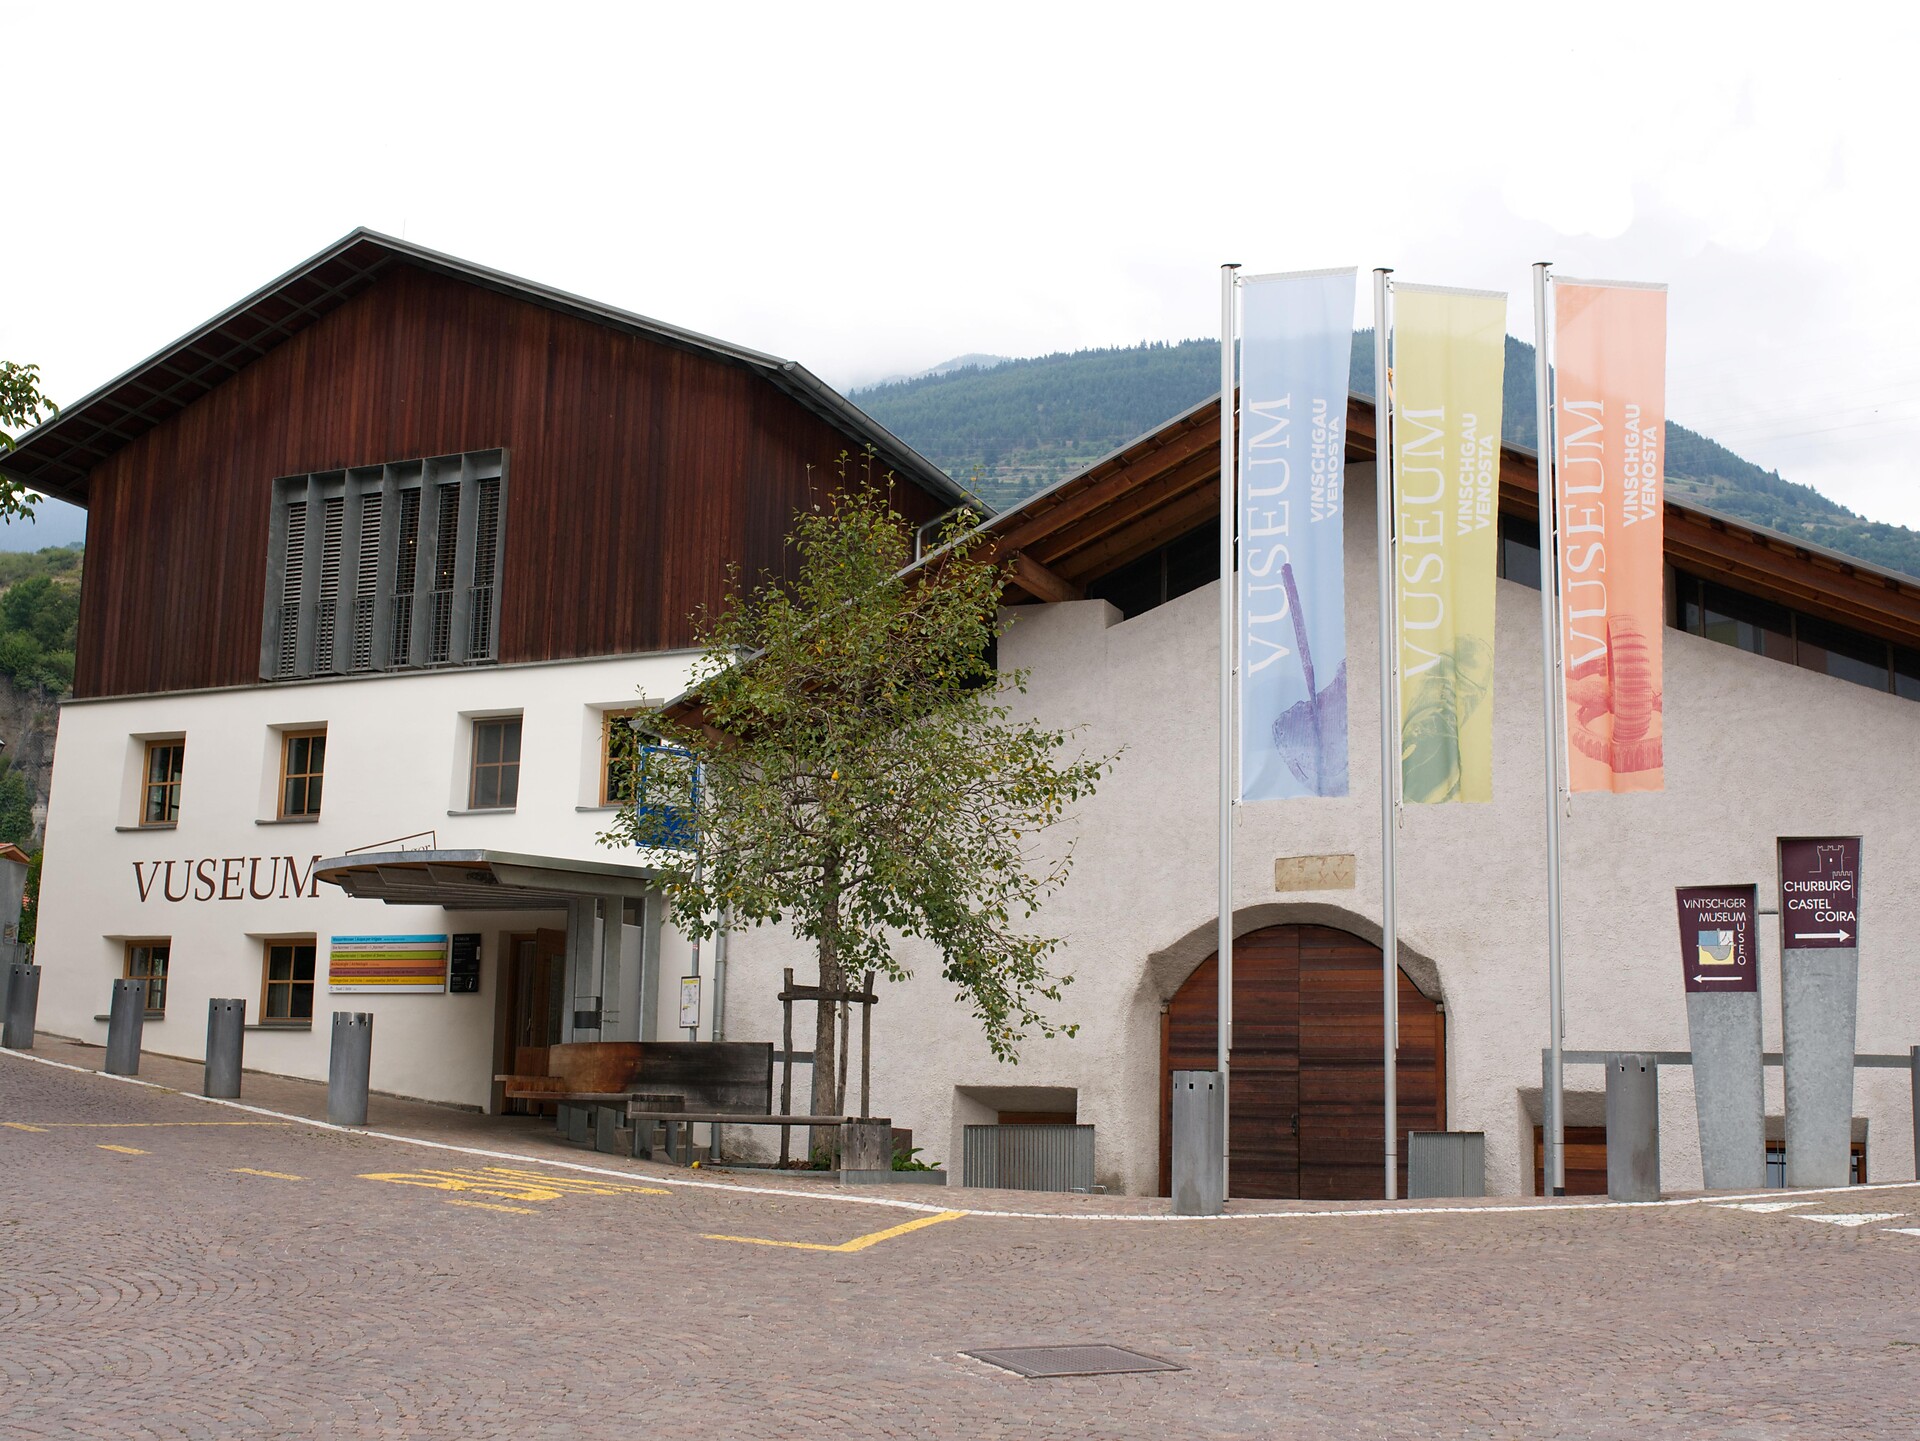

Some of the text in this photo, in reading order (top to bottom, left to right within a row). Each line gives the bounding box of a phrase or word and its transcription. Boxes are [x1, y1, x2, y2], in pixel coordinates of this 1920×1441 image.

[1310, 399, 1327, 523] VINSCHGAU
[1326, 416, 1340, 519] VENOSTA
[1456, 412, 1478, 536] VINSCHGAU
[1475, 434, 1494, 531] VENOSTA
[1622, 404, 1641, 528] VINSCHGAU
[1641, 426, 1657, 521] VENOSTA
[1246, 393, 1291, 678] VUSEUM
[1401, 404, 1446, 681] VUSEUM
[1563, 397, 1608, 671] VUSEUM
[132, 854, 322, 903] VUSEUM
[1683, 898, 1746, 909] VINTSCHGER
[1698, 912, 1747, 922] MUSEUM
[1783, 880, 1852, 892] CHURBURG
[1788, 899, 1832, 910] CASTEL
[1814, 911, 1856, 922] COIRA
